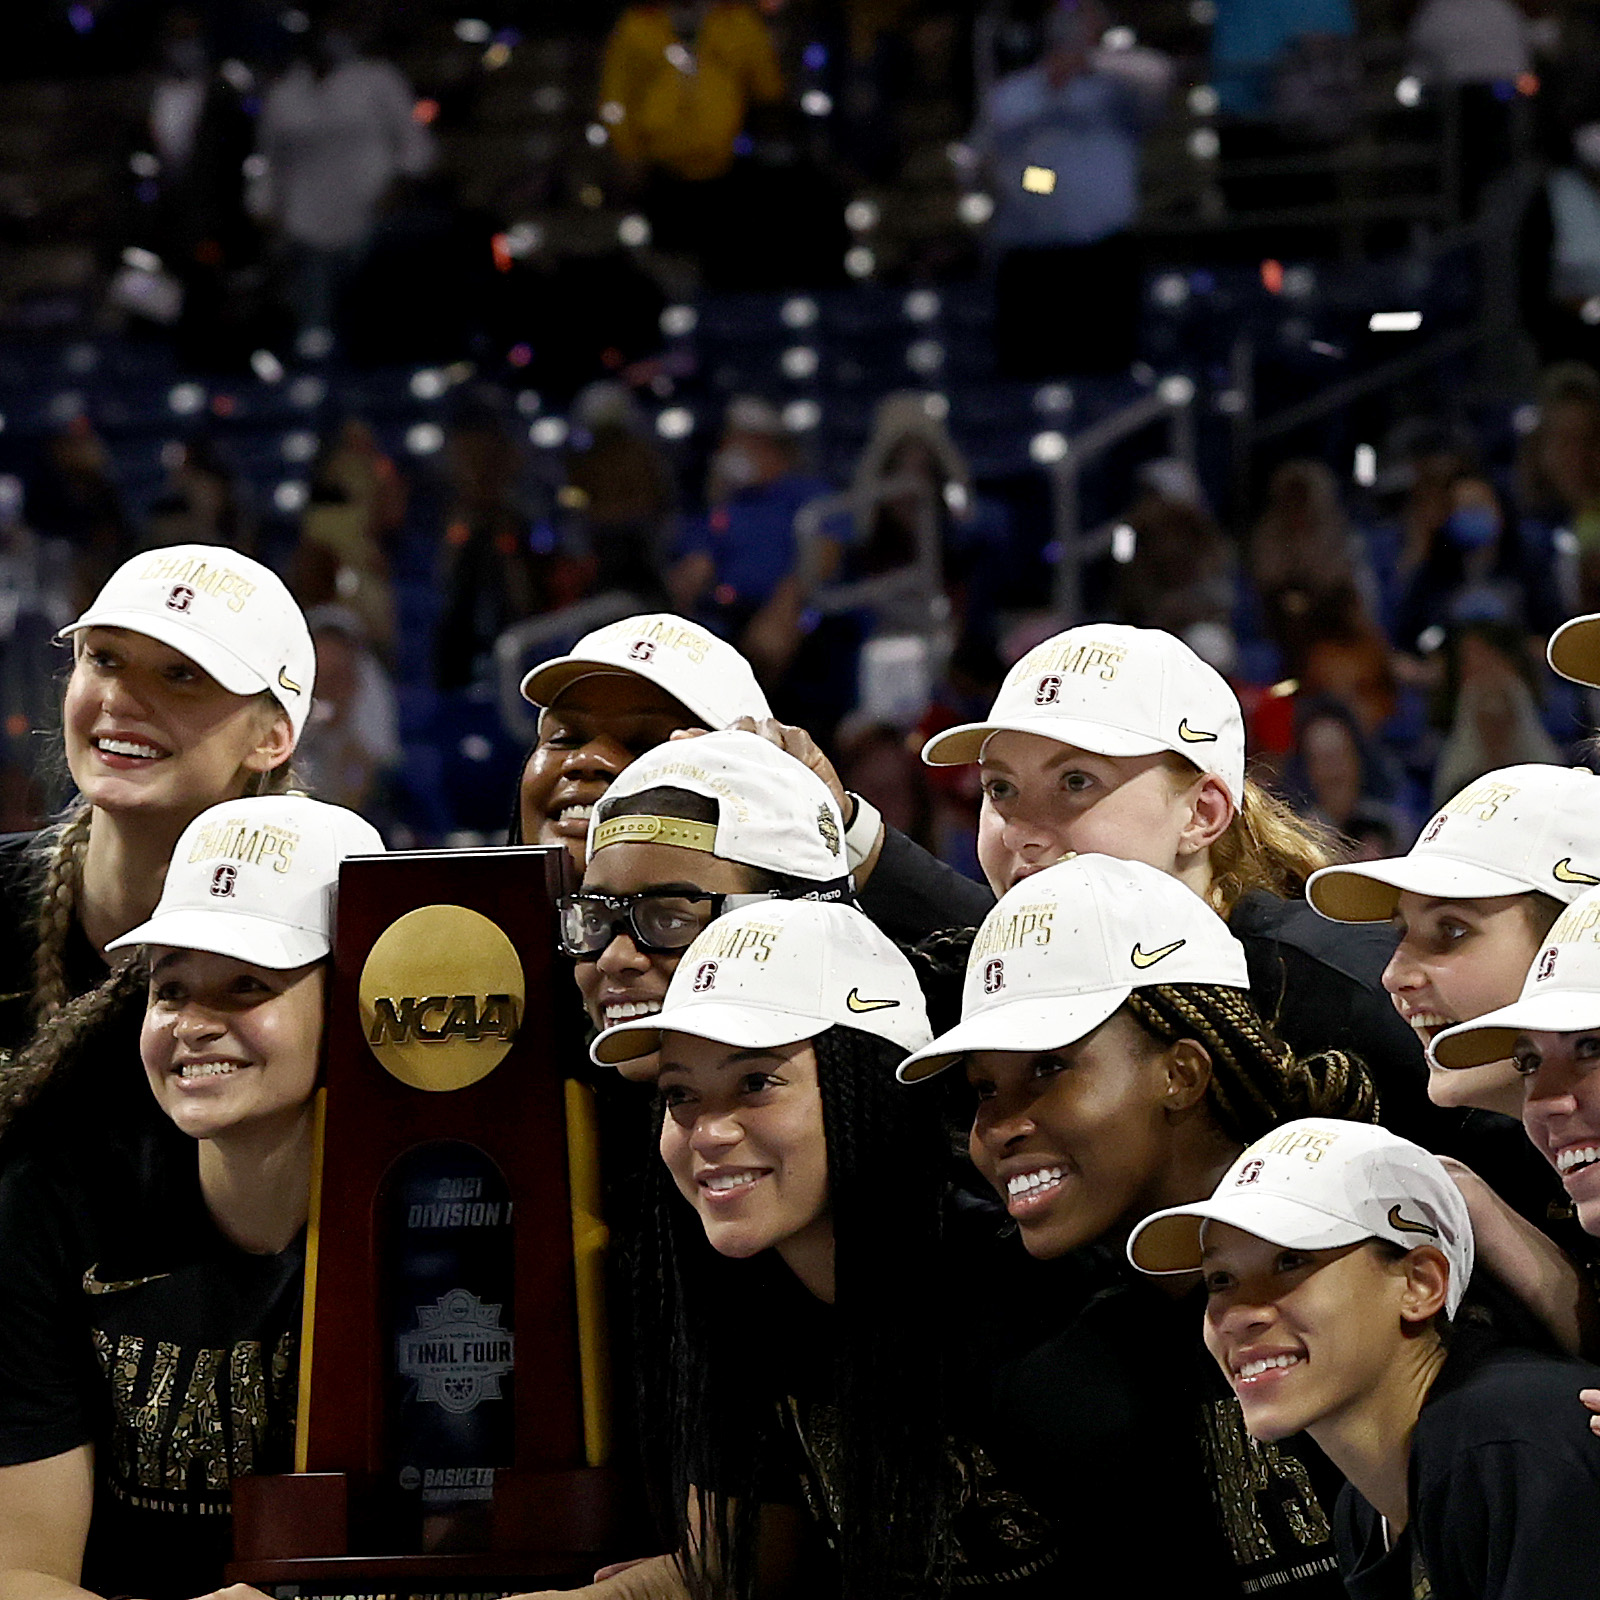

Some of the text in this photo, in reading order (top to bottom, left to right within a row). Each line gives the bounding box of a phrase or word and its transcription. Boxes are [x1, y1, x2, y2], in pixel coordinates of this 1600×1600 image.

[370, 994, 514, 1045] NCAA
[408, 1202, 499, 1228] DIVISION
[407, 1340, 511, 1364] FINAL FOUR
